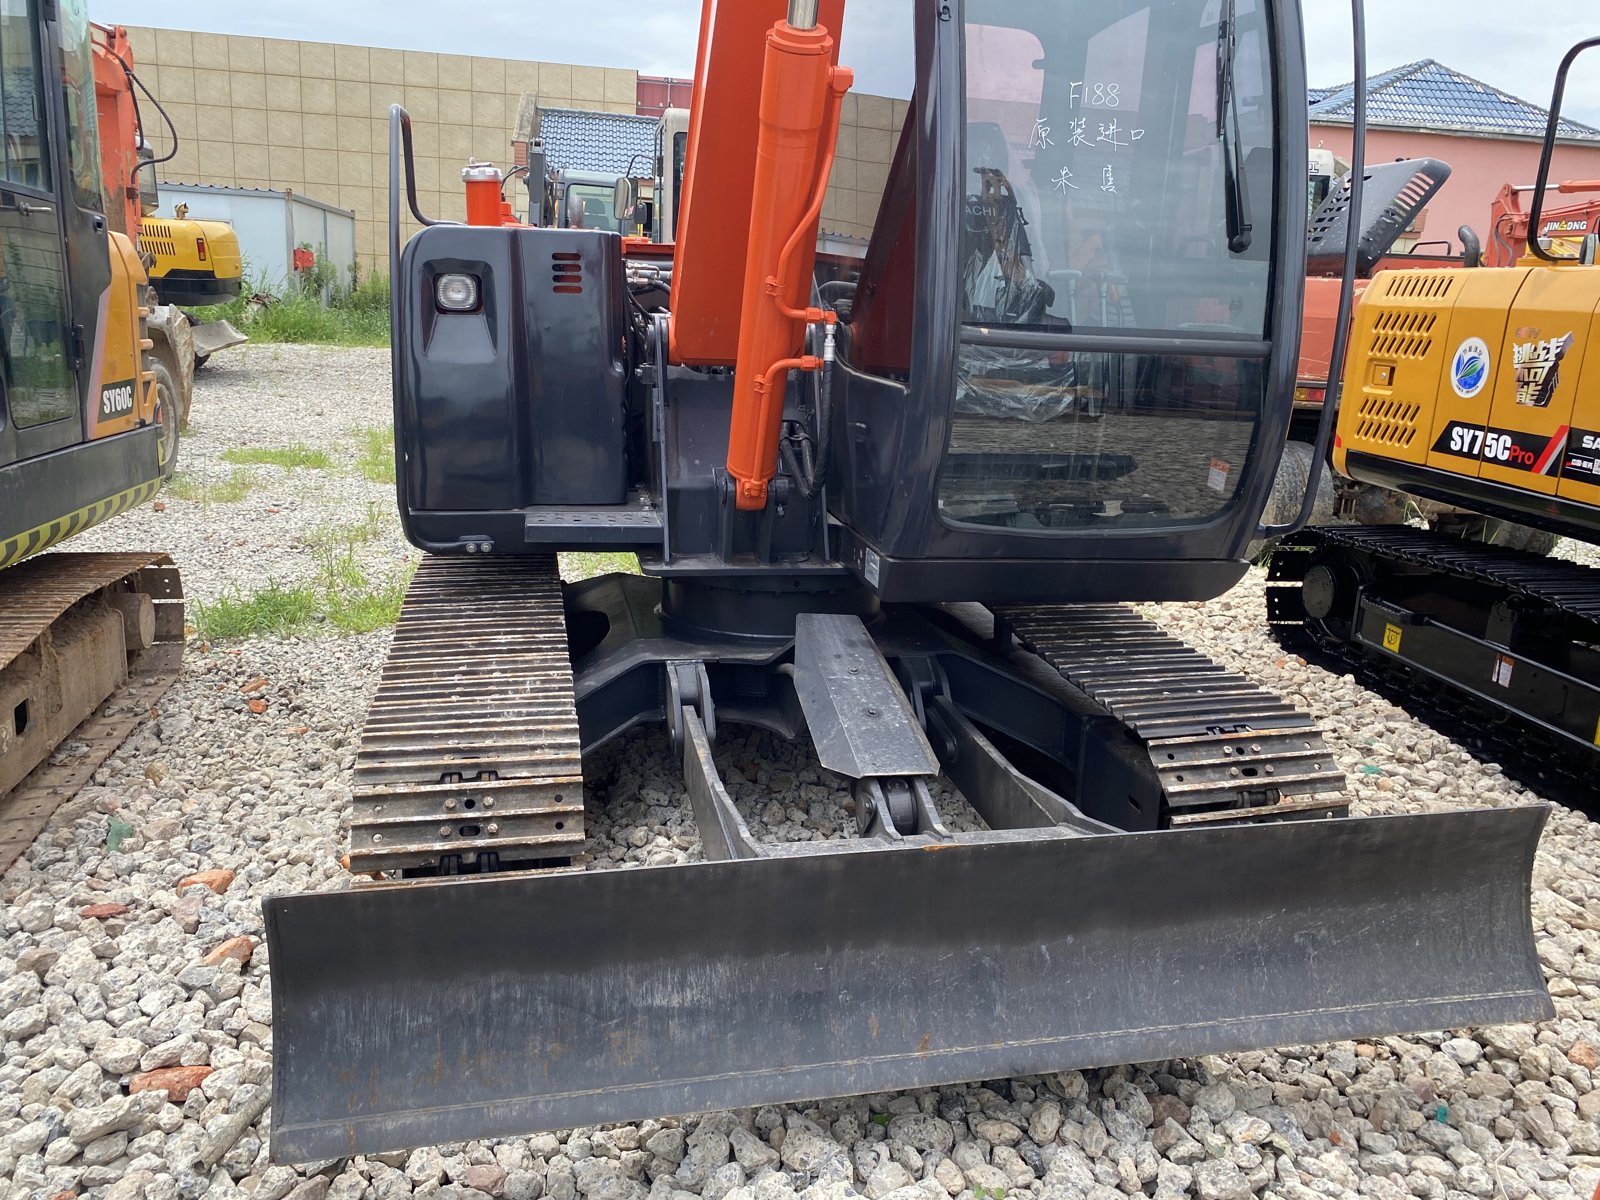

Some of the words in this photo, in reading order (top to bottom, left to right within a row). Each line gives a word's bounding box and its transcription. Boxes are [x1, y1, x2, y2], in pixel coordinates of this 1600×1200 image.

[1069, 81, 1121, 109] F188
[1028, 117, 1145, 151] 原装进口
[103, 385, 132, 414] SY60C
